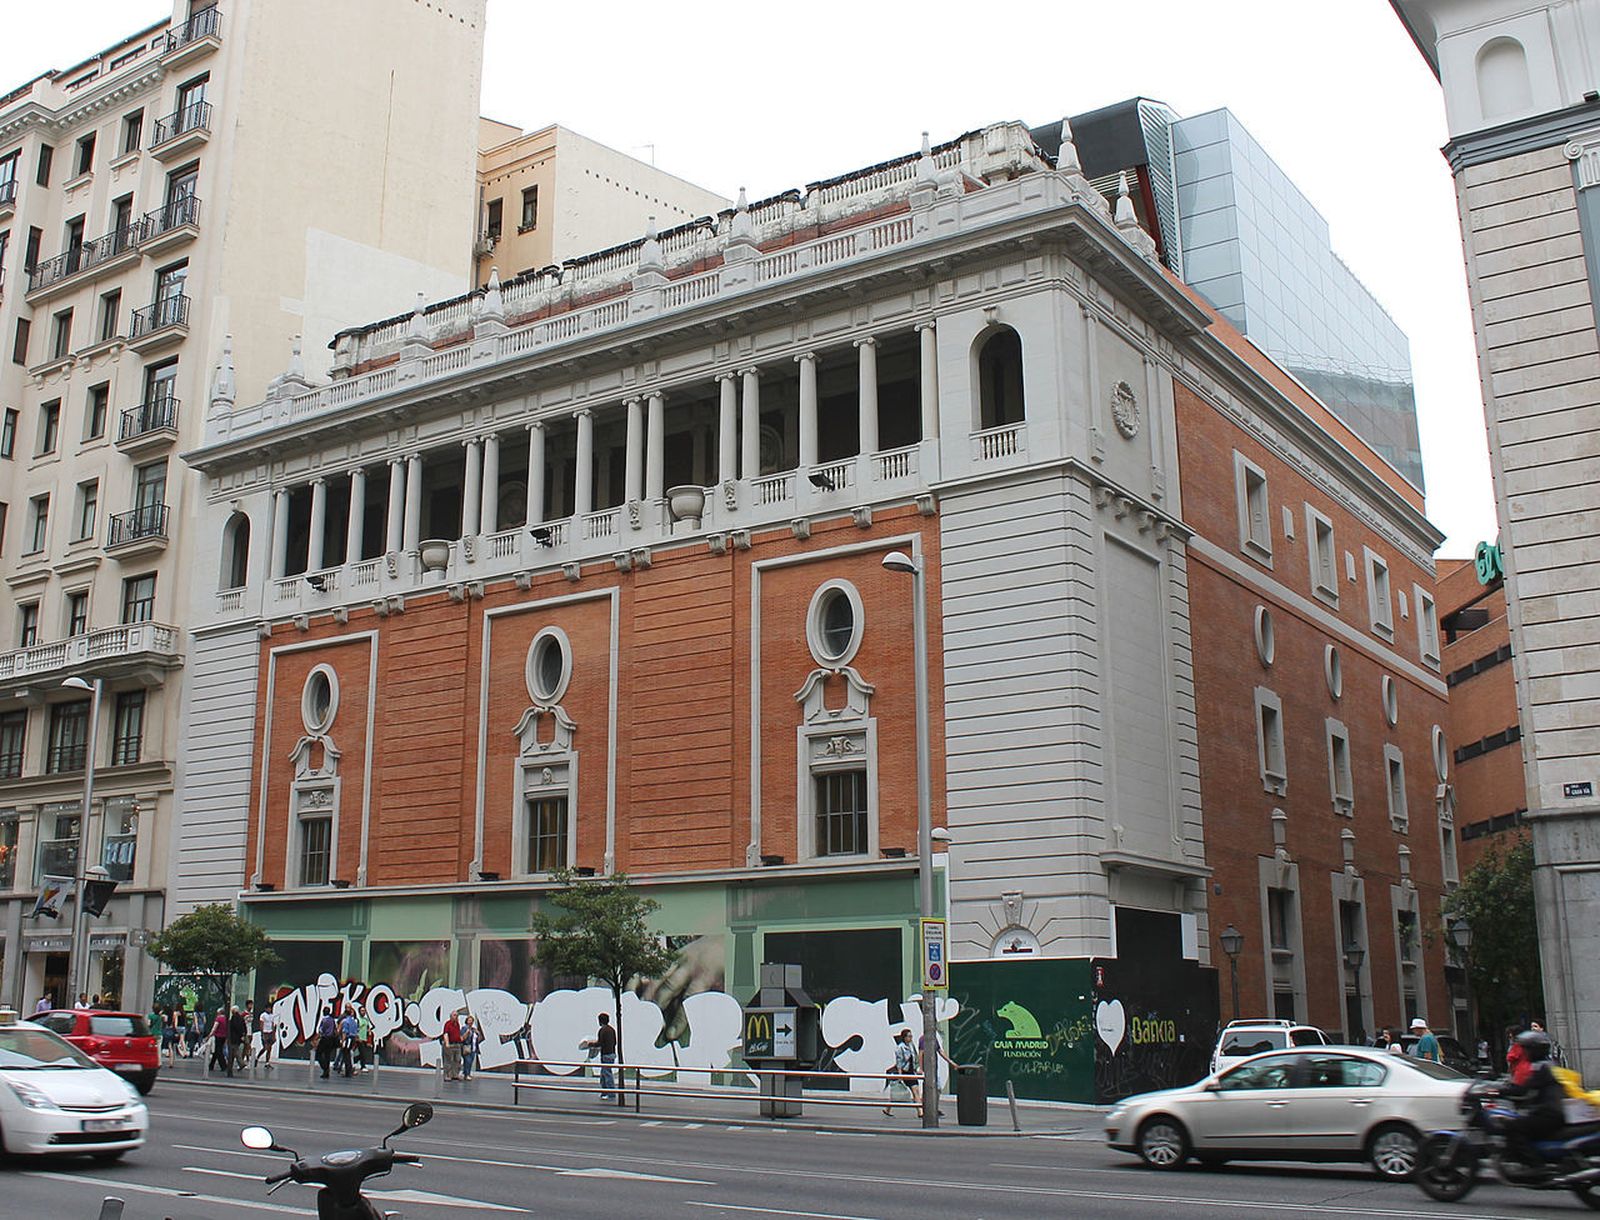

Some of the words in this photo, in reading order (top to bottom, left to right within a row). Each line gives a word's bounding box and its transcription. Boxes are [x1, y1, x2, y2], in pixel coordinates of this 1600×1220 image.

[1132, 1016, 1176, 1044] Bankia
[994, 1040, 1013, 1049] CAJA
[1015, 1040, 1049, 1049] MADRID
[1003, 1050, 1042, 1058] FUNDACIÓN
